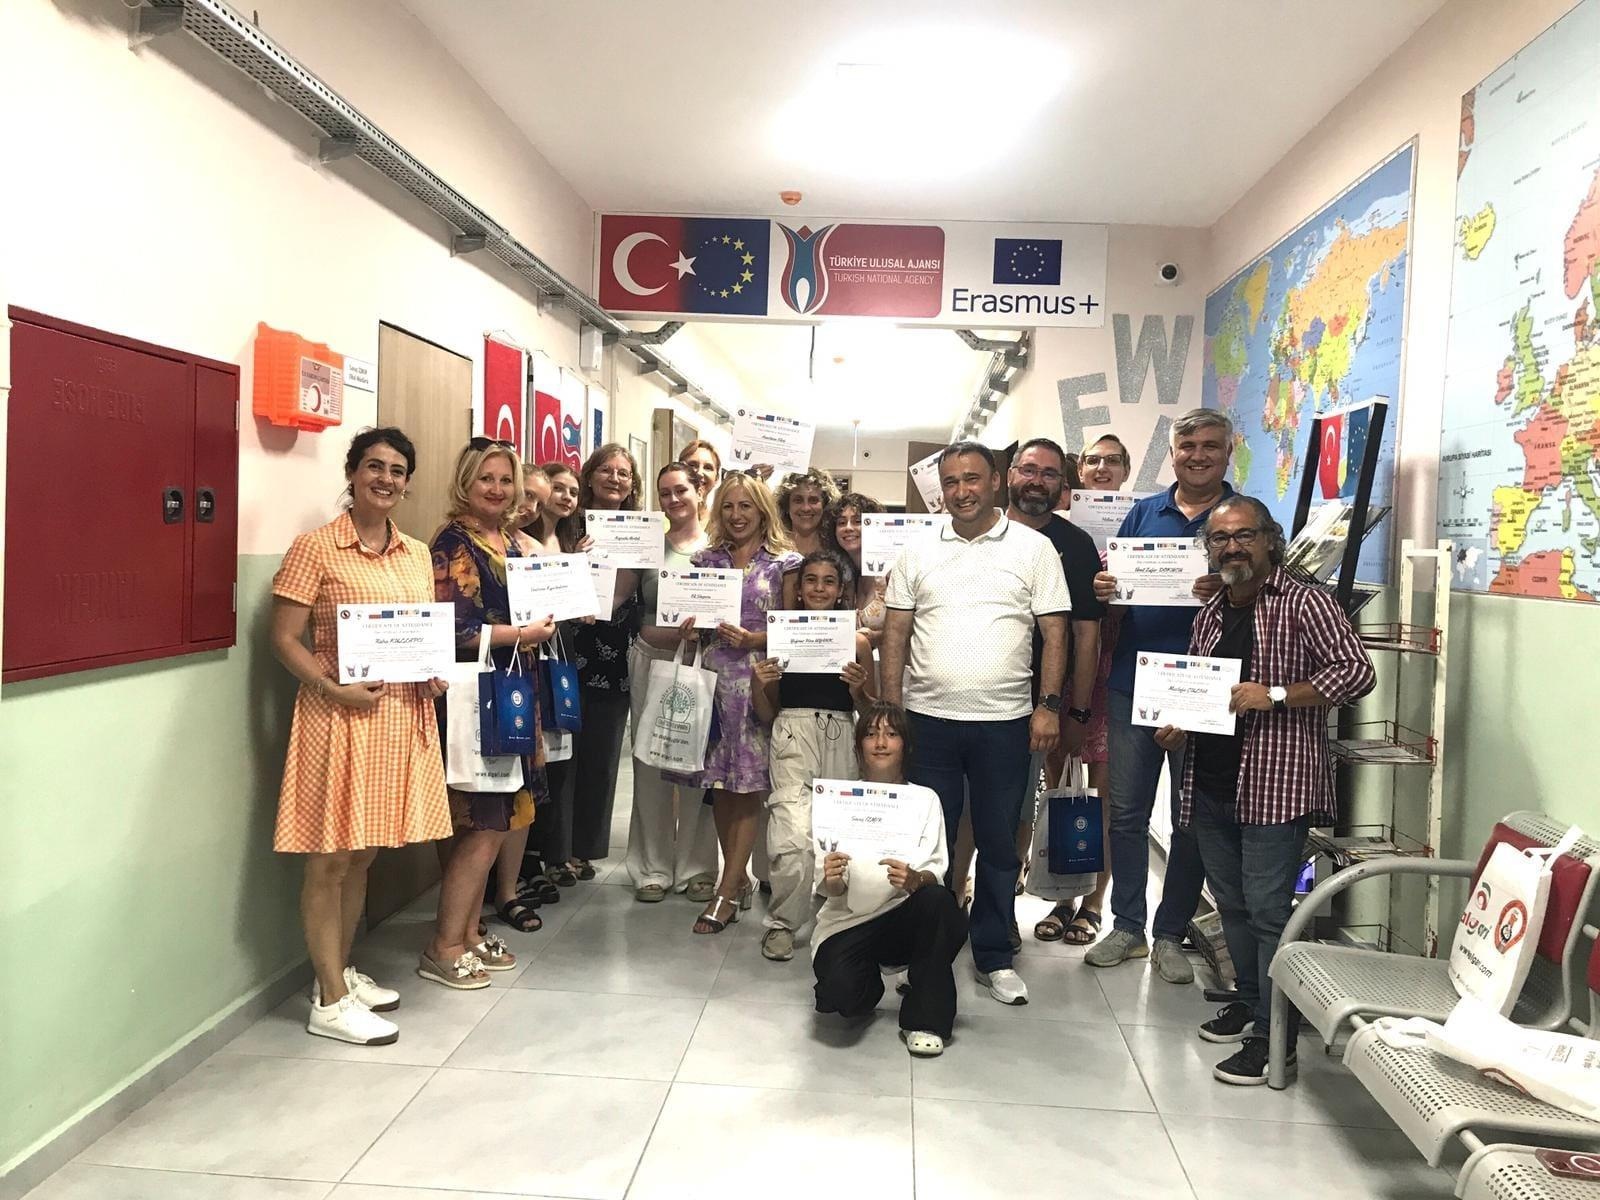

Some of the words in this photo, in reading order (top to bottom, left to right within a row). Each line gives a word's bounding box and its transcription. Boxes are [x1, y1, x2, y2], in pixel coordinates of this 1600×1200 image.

[829, 255, 867, 267] TÜRKİYE
[869, 258, 905, 269] ULUSAL
[907, 259, 941, 269] AJANSI
[833, 272, 864, 282] TURKISH
[867, 273, 903, 284] NATIONAL
[904, 275, 935, 285] AGENCY
[952, 288, 1099, 315] Erasmus+
[1112, 314, 1194, 405] W
